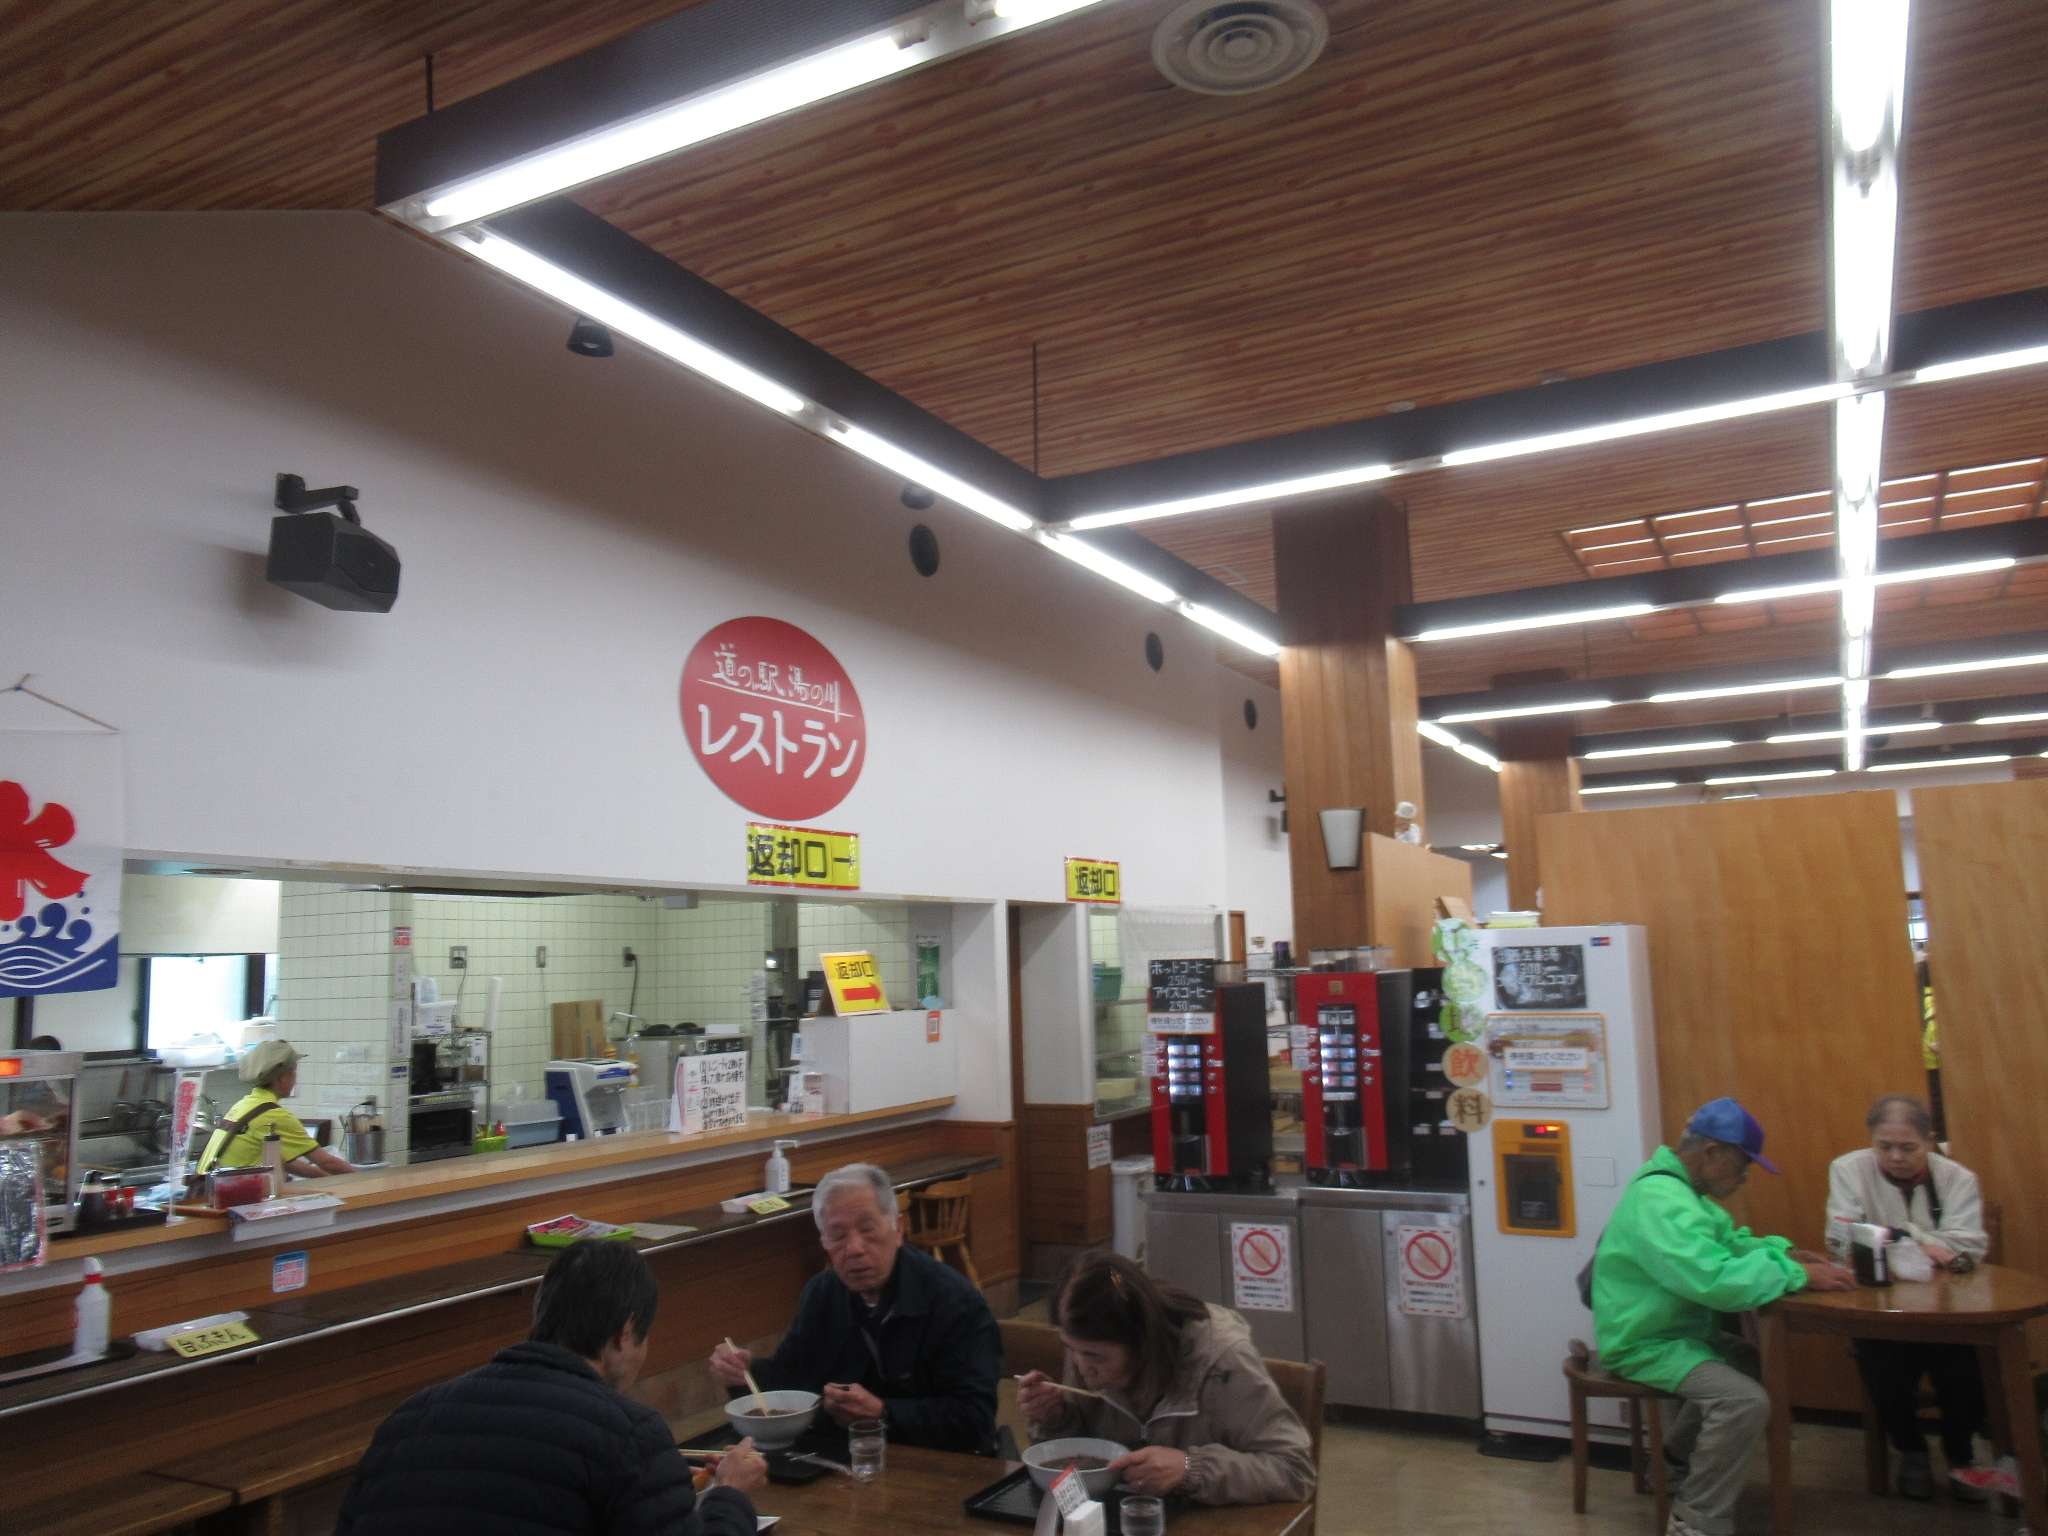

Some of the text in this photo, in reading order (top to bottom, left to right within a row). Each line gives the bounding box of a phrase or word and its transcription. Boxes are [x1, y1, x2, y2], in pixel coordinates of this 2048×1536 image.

[712, 643, 840, 723] 道の駅 湯の川
[698, 704, 858, 779] レストラン
[747, 833, 827, 878] 返却口
[1075, 866, 1115, 896] 返却口
[834, 960, 874, 979] 返却口
[1151, 961, 1213, 975] ホットコーヒー
[1152, 986, 1213, 999] アイスコーヒー
